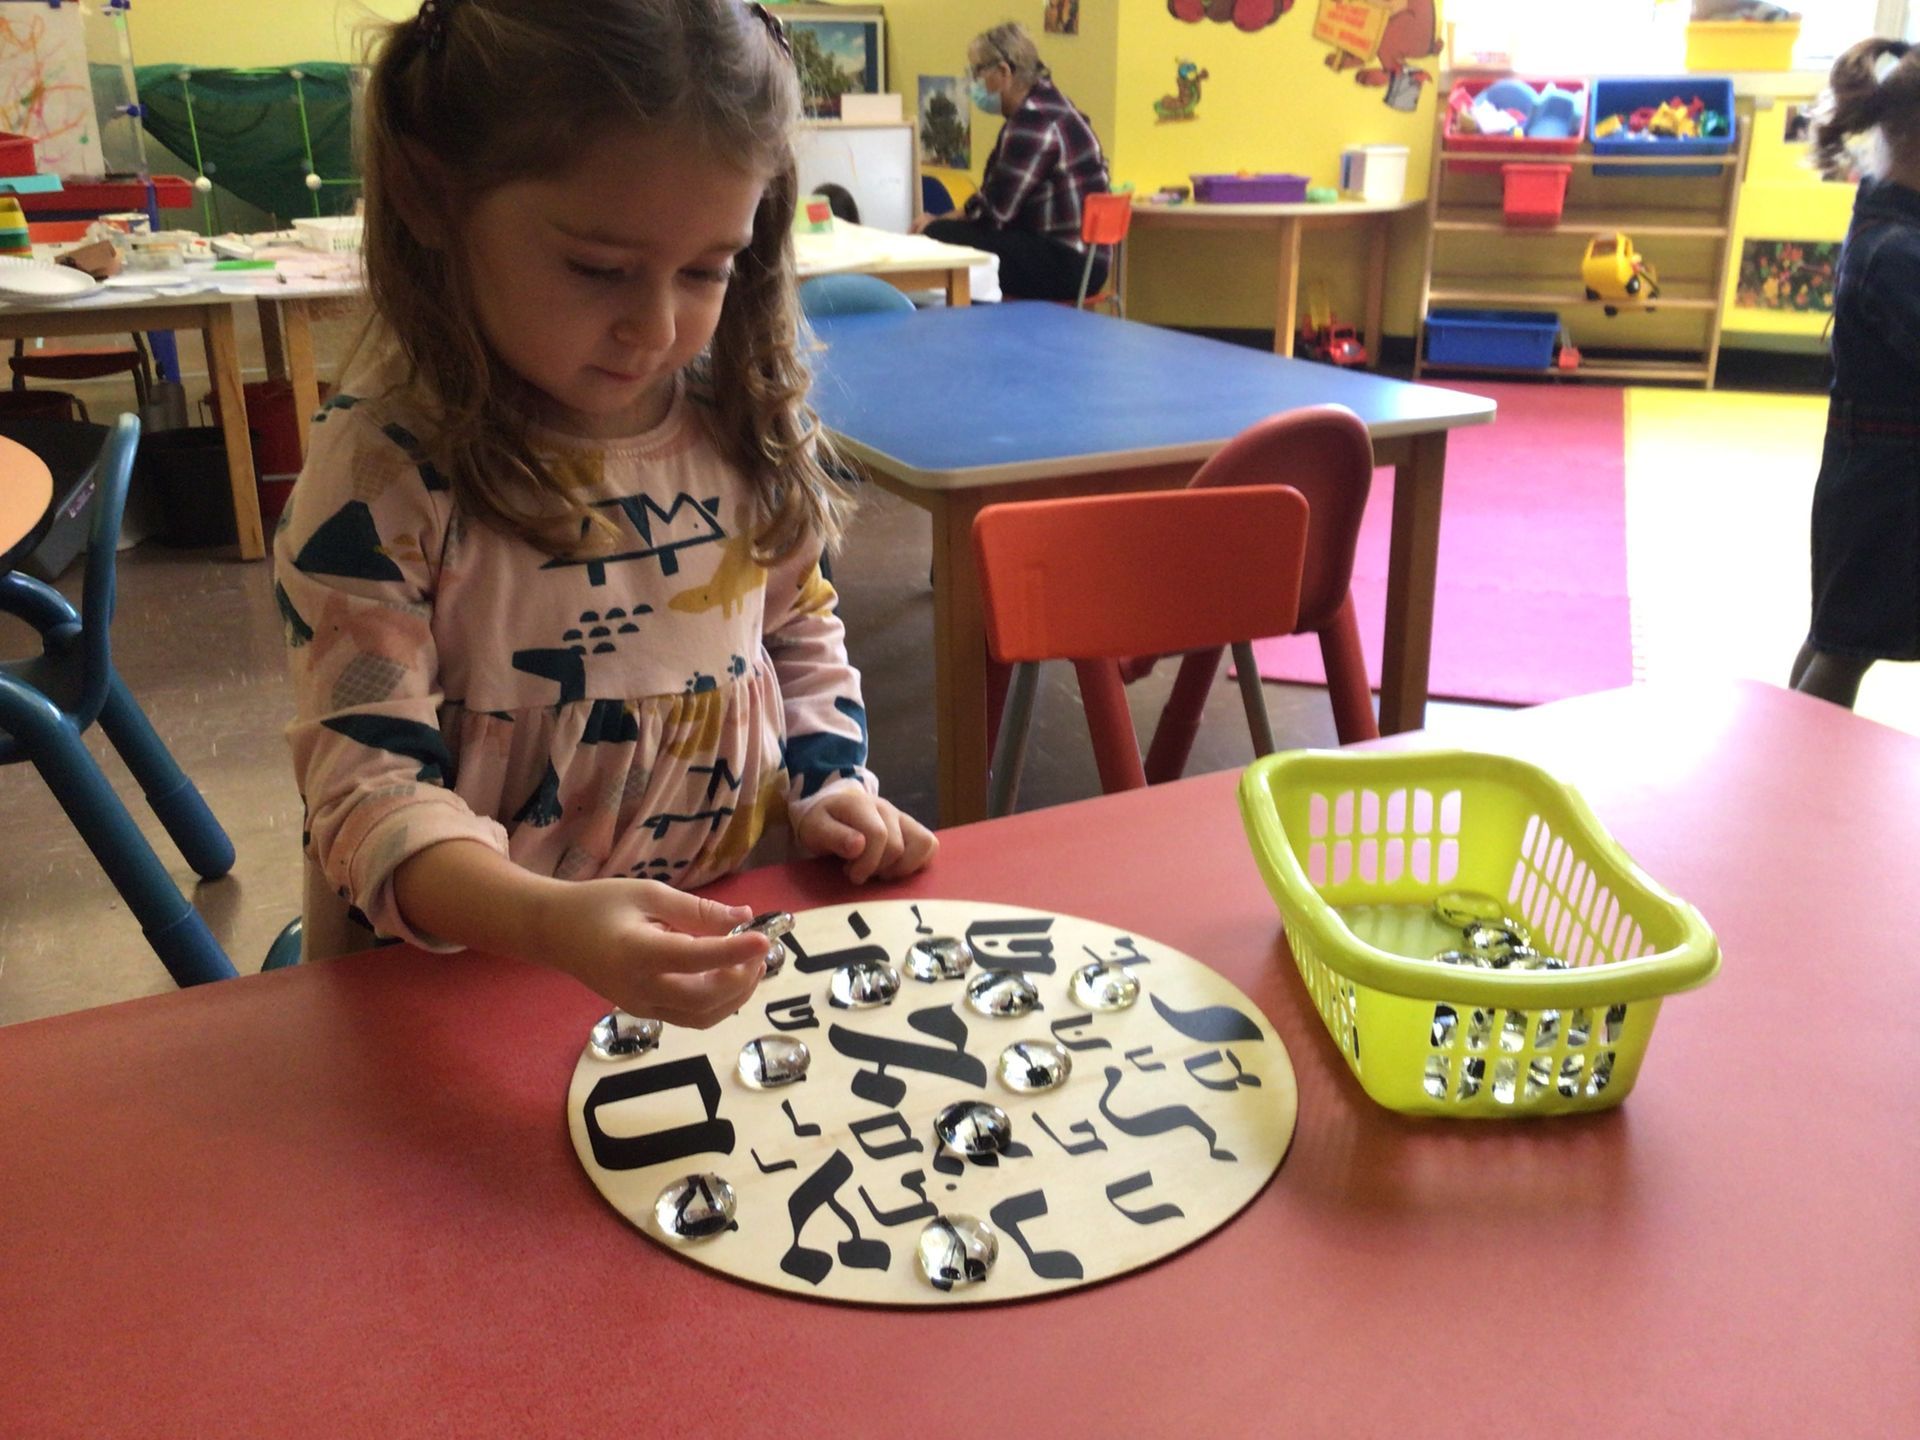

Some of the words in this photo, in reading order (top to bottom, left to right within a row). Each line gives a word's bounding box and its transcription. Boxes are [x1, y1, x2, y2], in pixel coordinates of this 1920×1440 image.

[829, 1004, 987, 1108] א
[1099, 1066, 1238, 1162] ל
[780, 1150, 891, 1286] ע
